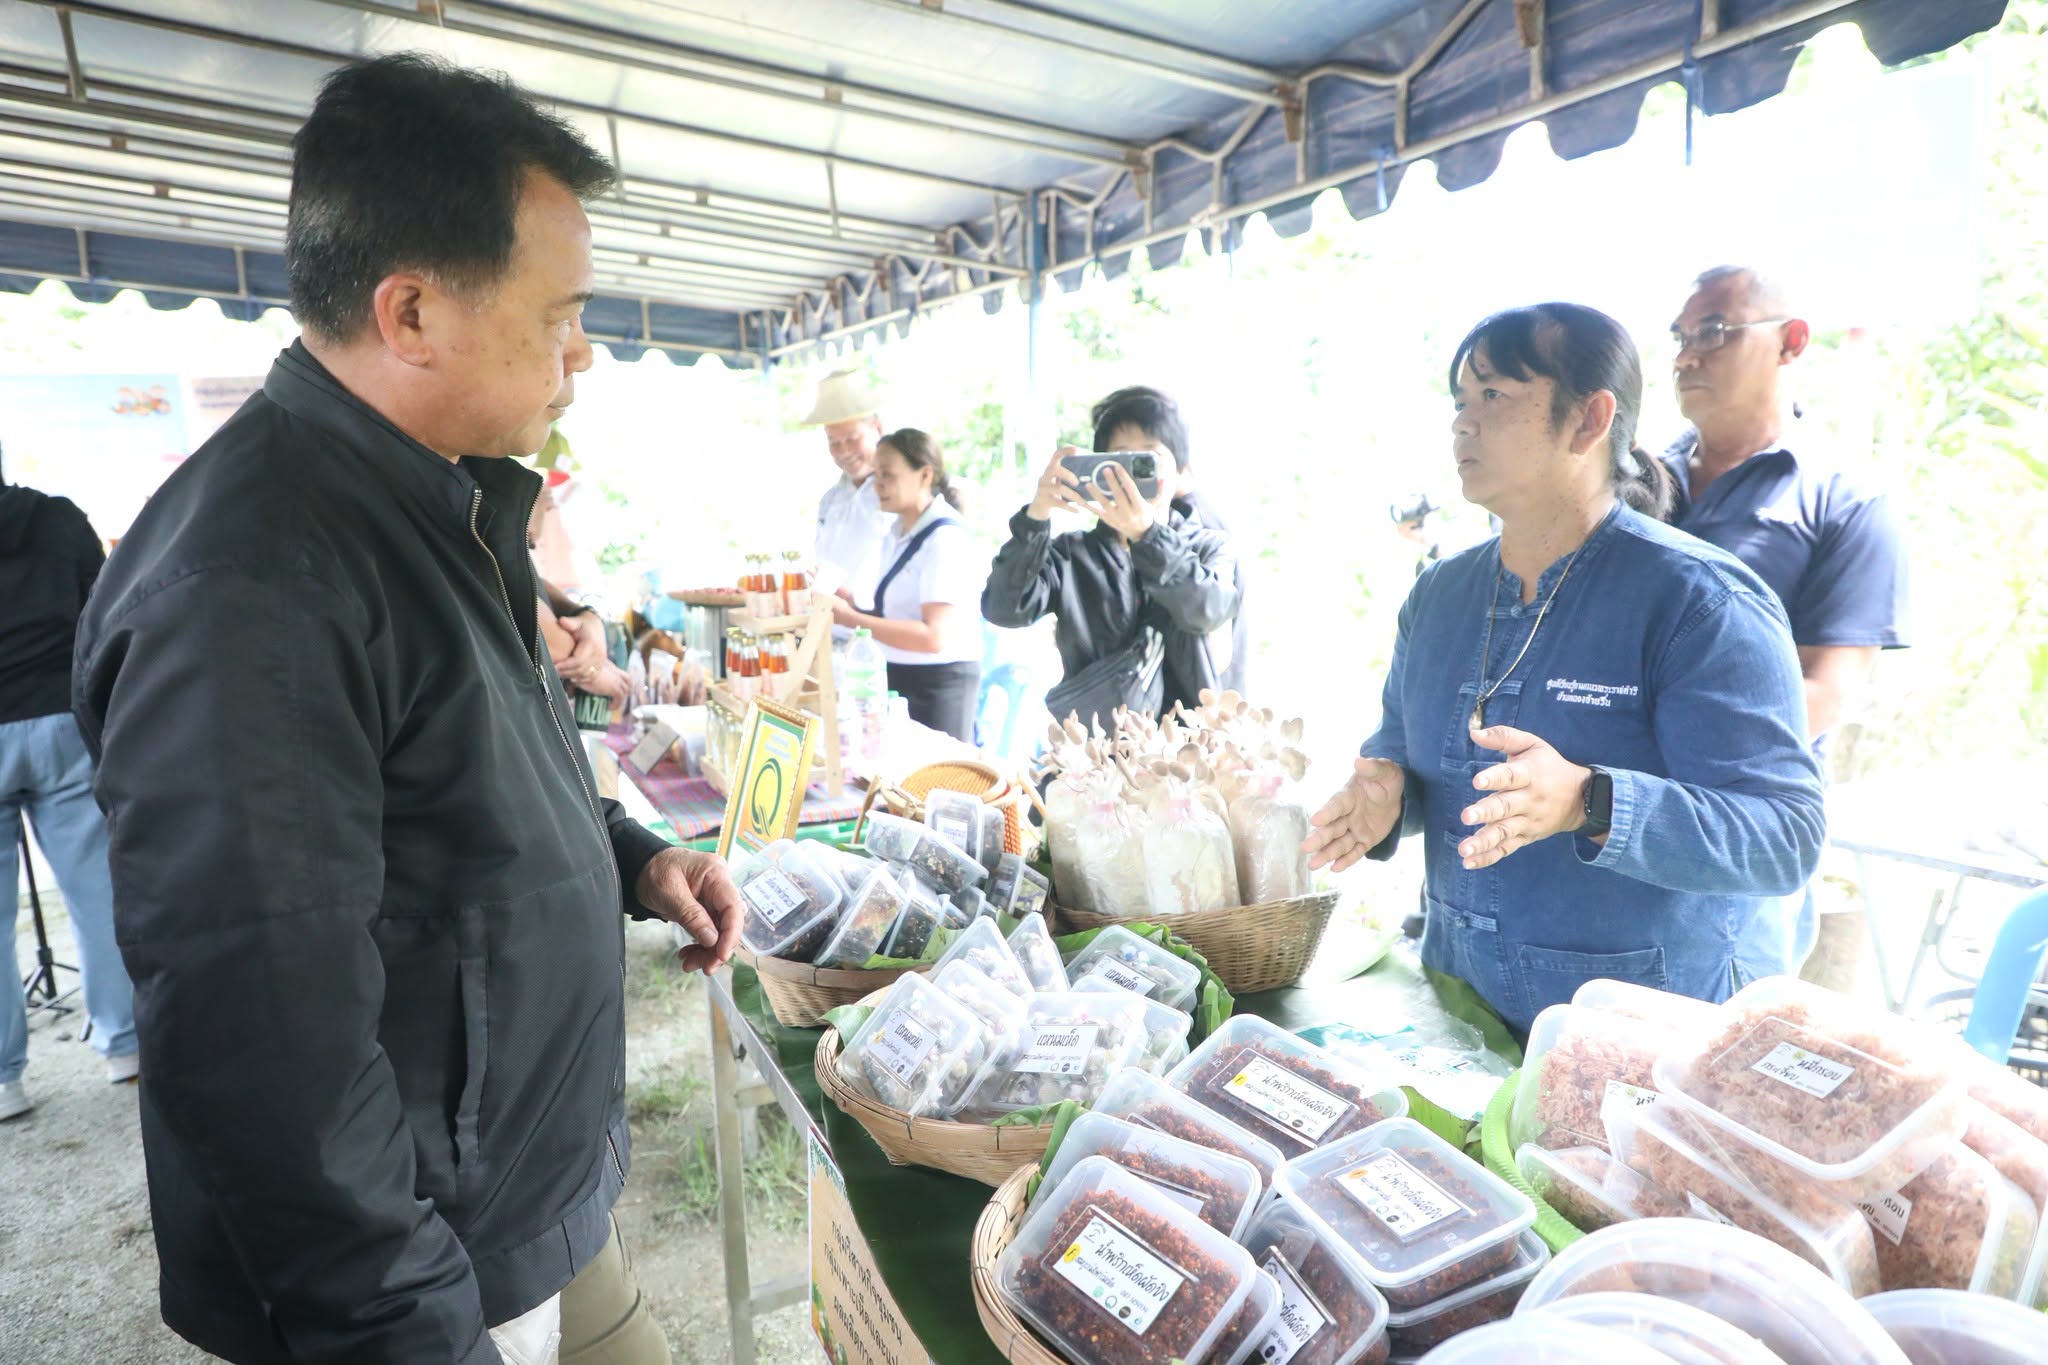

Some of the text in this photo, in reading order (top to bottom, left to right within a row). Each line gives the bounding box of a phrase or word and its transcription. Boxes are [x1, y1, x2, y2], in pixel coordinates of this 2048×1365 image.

[1797, 1058, 1843, 1081] หมี่กรอบ
[832, 1220, 903, 1346] กลุ่มวิสาหกิจชุมชน
[1095, 1239, 1170, 1301] น้ำพริกเห็ดผัดขิง
